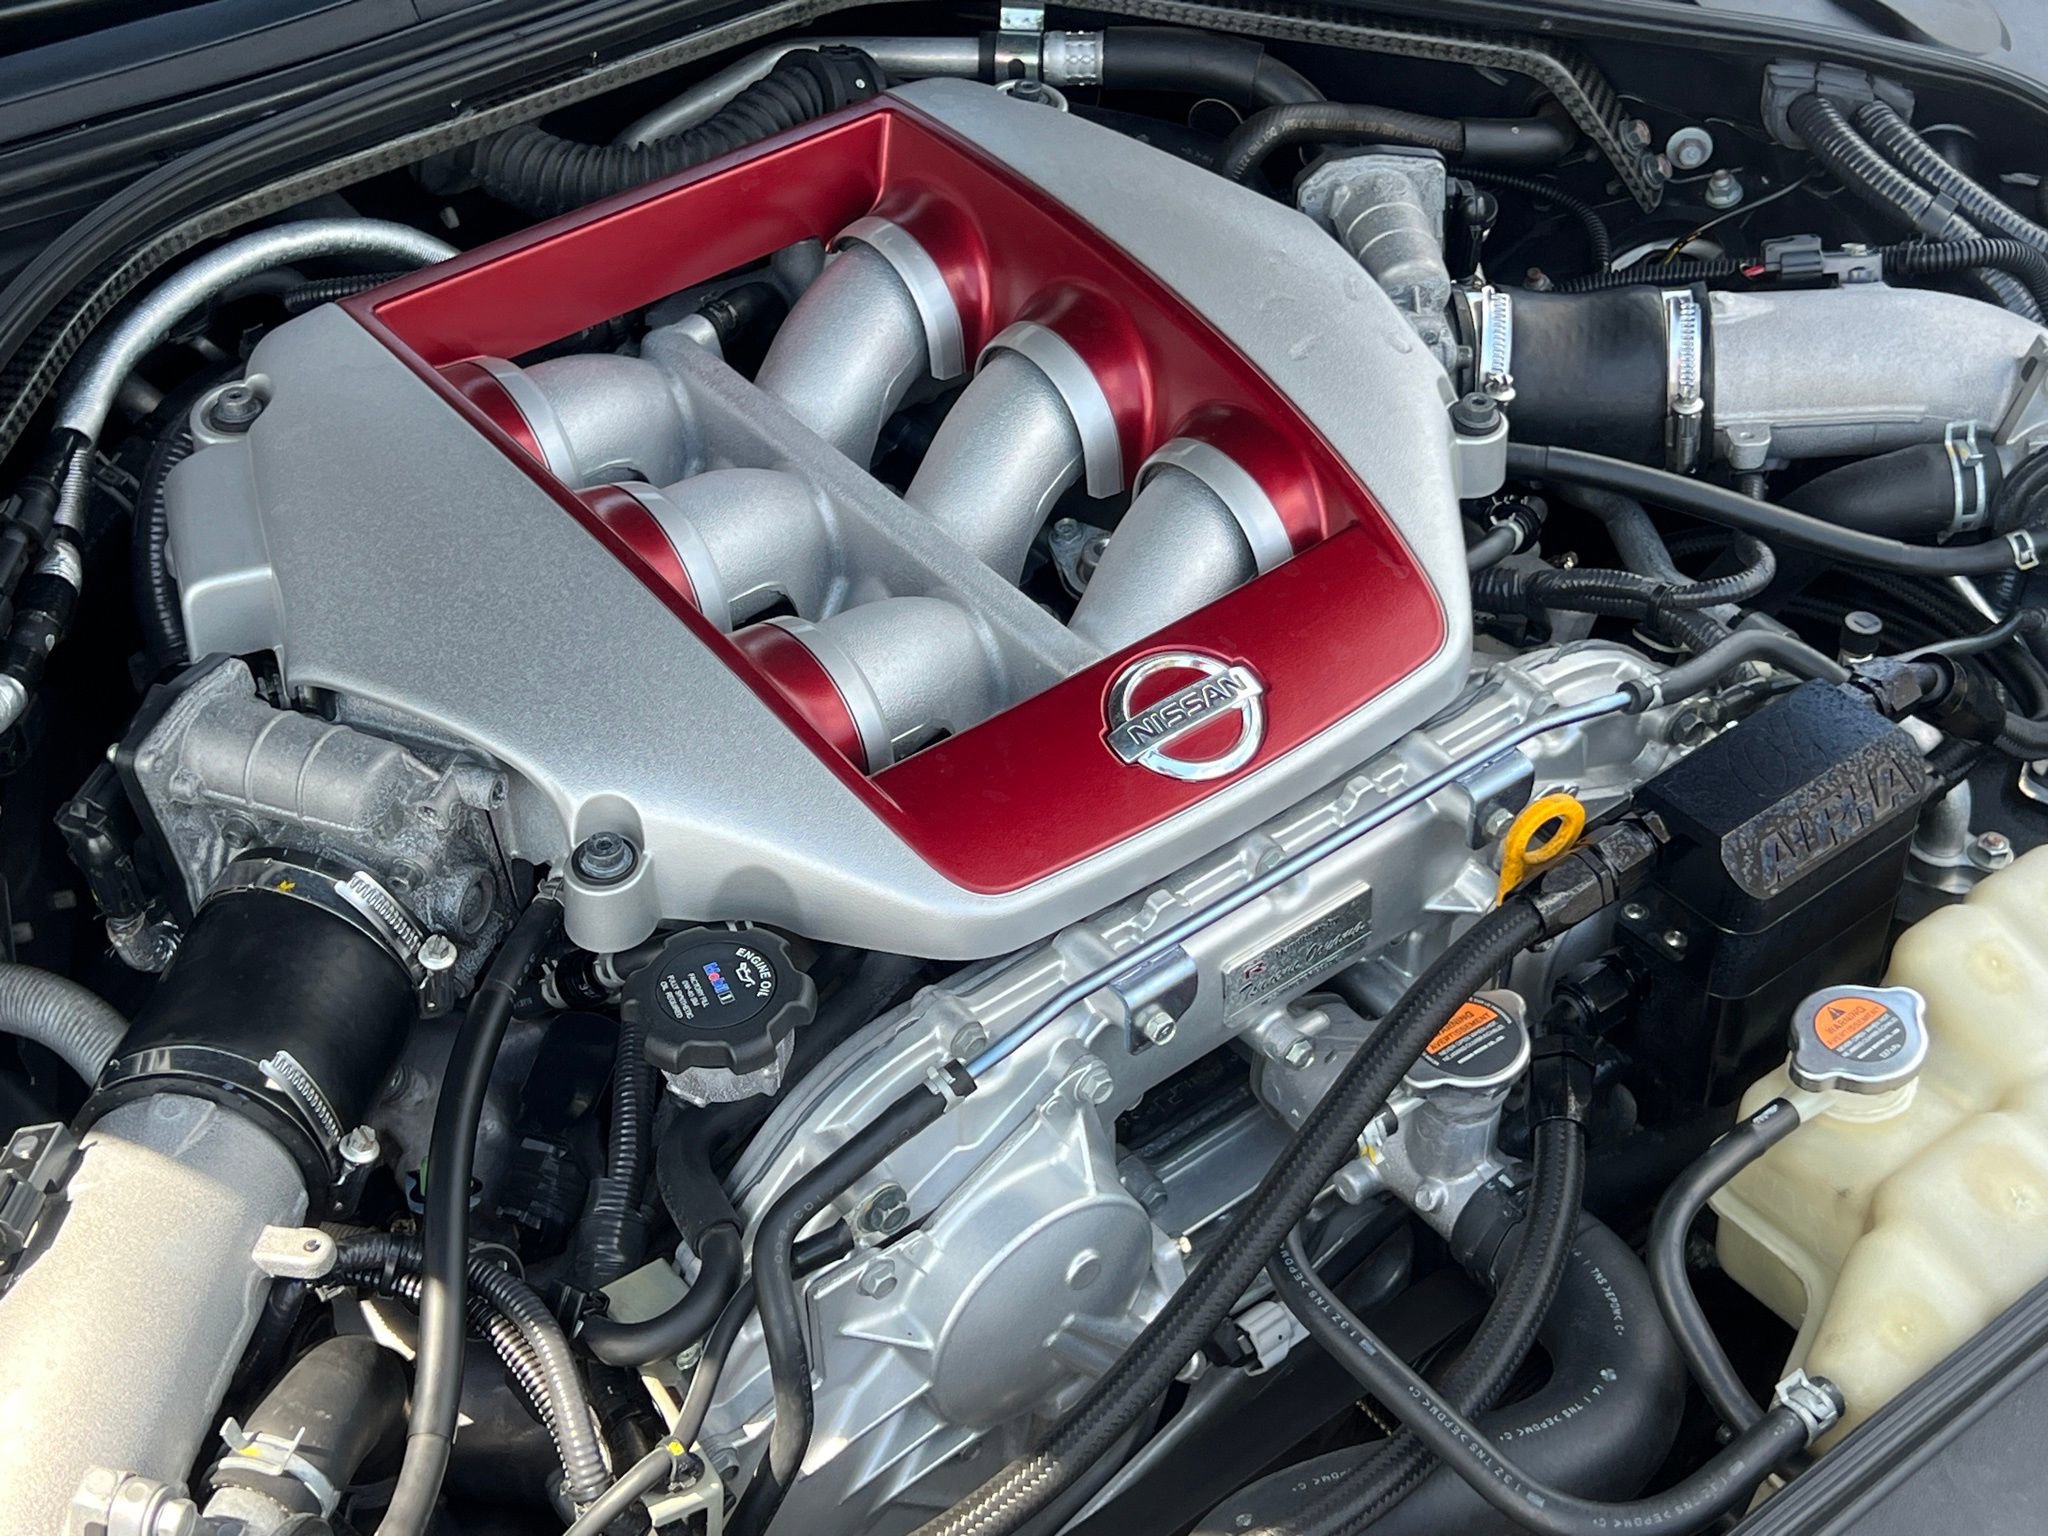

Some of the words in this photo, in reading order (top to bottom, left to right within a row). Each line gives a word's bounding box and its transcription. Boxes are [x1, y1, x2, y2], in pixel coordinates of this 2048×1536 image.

[1126, 674, 1250, 746] NISSAN
[702, 961, 730, 994] Mobil
[735, 947, 771, 979] ENGINE
[757, 980, 771, 998] OIL
[1441, 1011, 1474, 1033] ARNING
